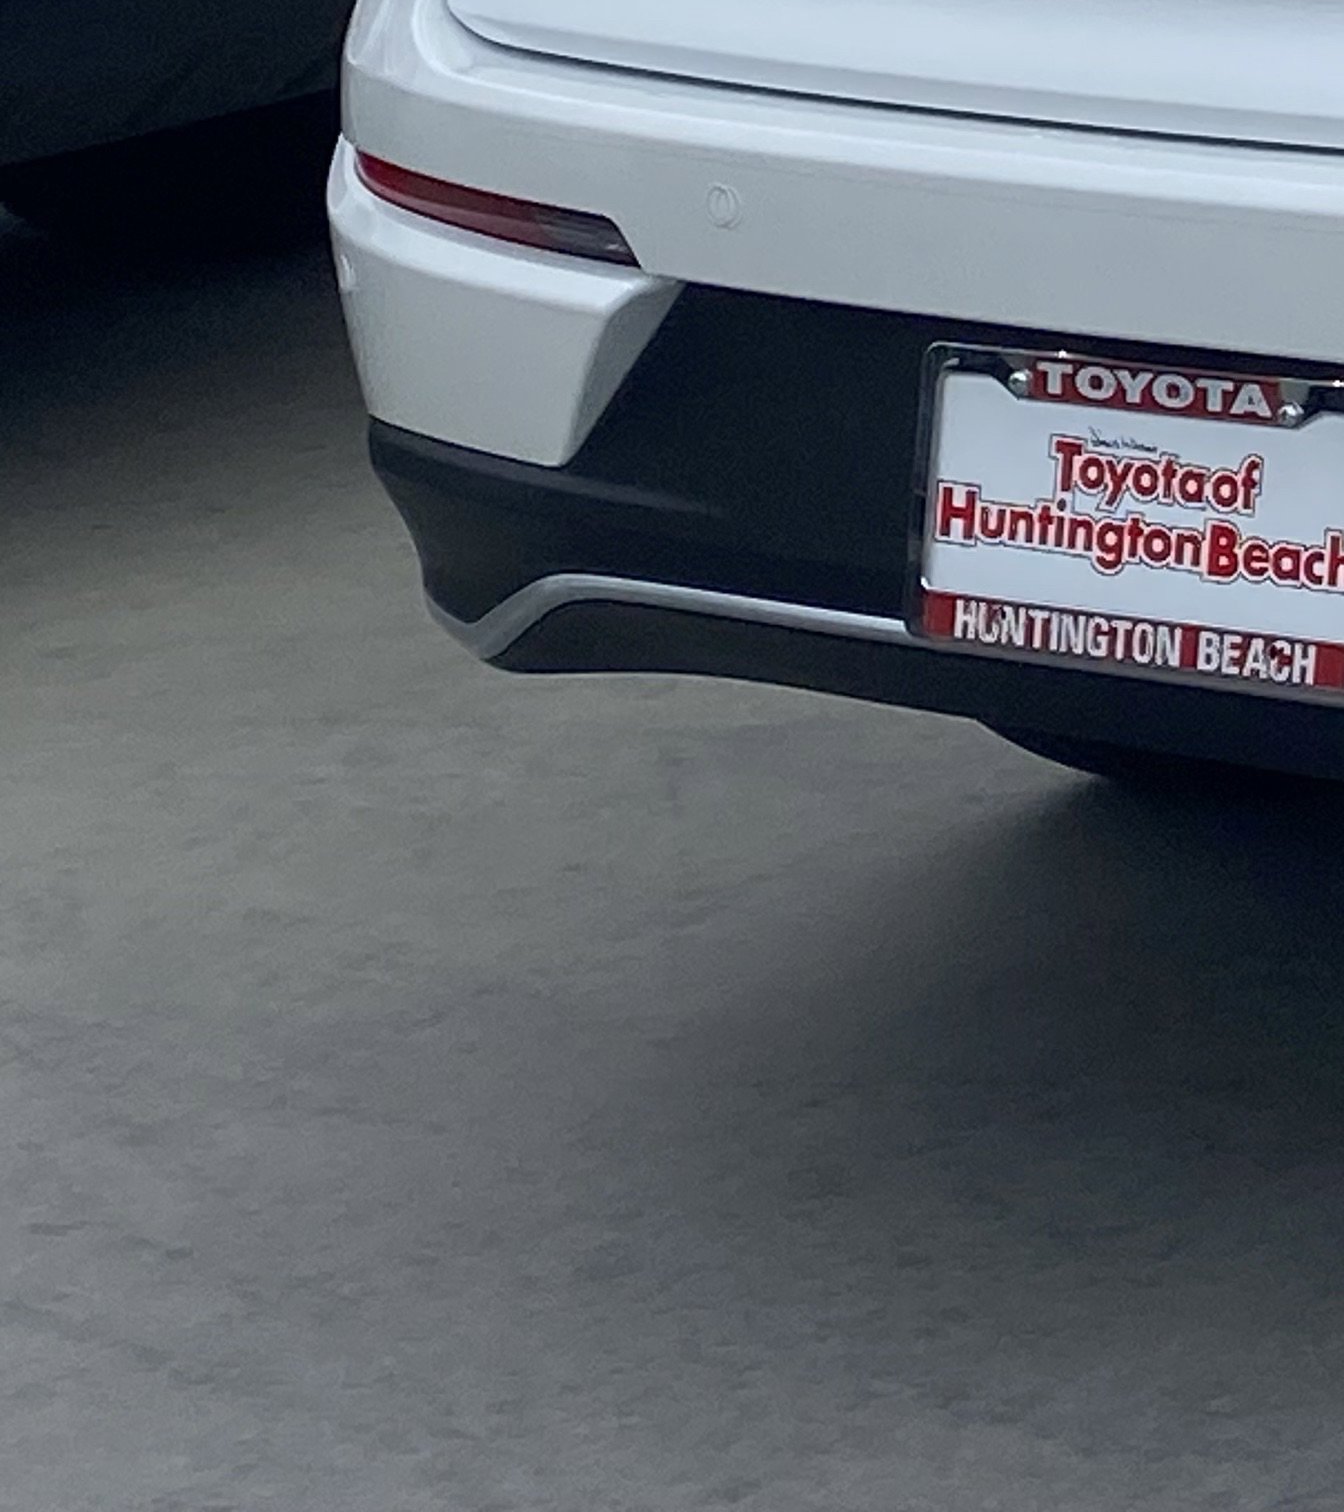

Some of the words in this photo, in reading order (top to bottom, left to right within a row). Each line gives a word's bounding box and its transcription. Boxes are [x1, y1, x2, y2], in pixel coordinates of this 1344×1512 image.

[1037, 362, 1273, 419] TOYOTA
[953, 597, 1183, 667] HUNTINGTON
[1196, 629, 1317, 686] BEACH
